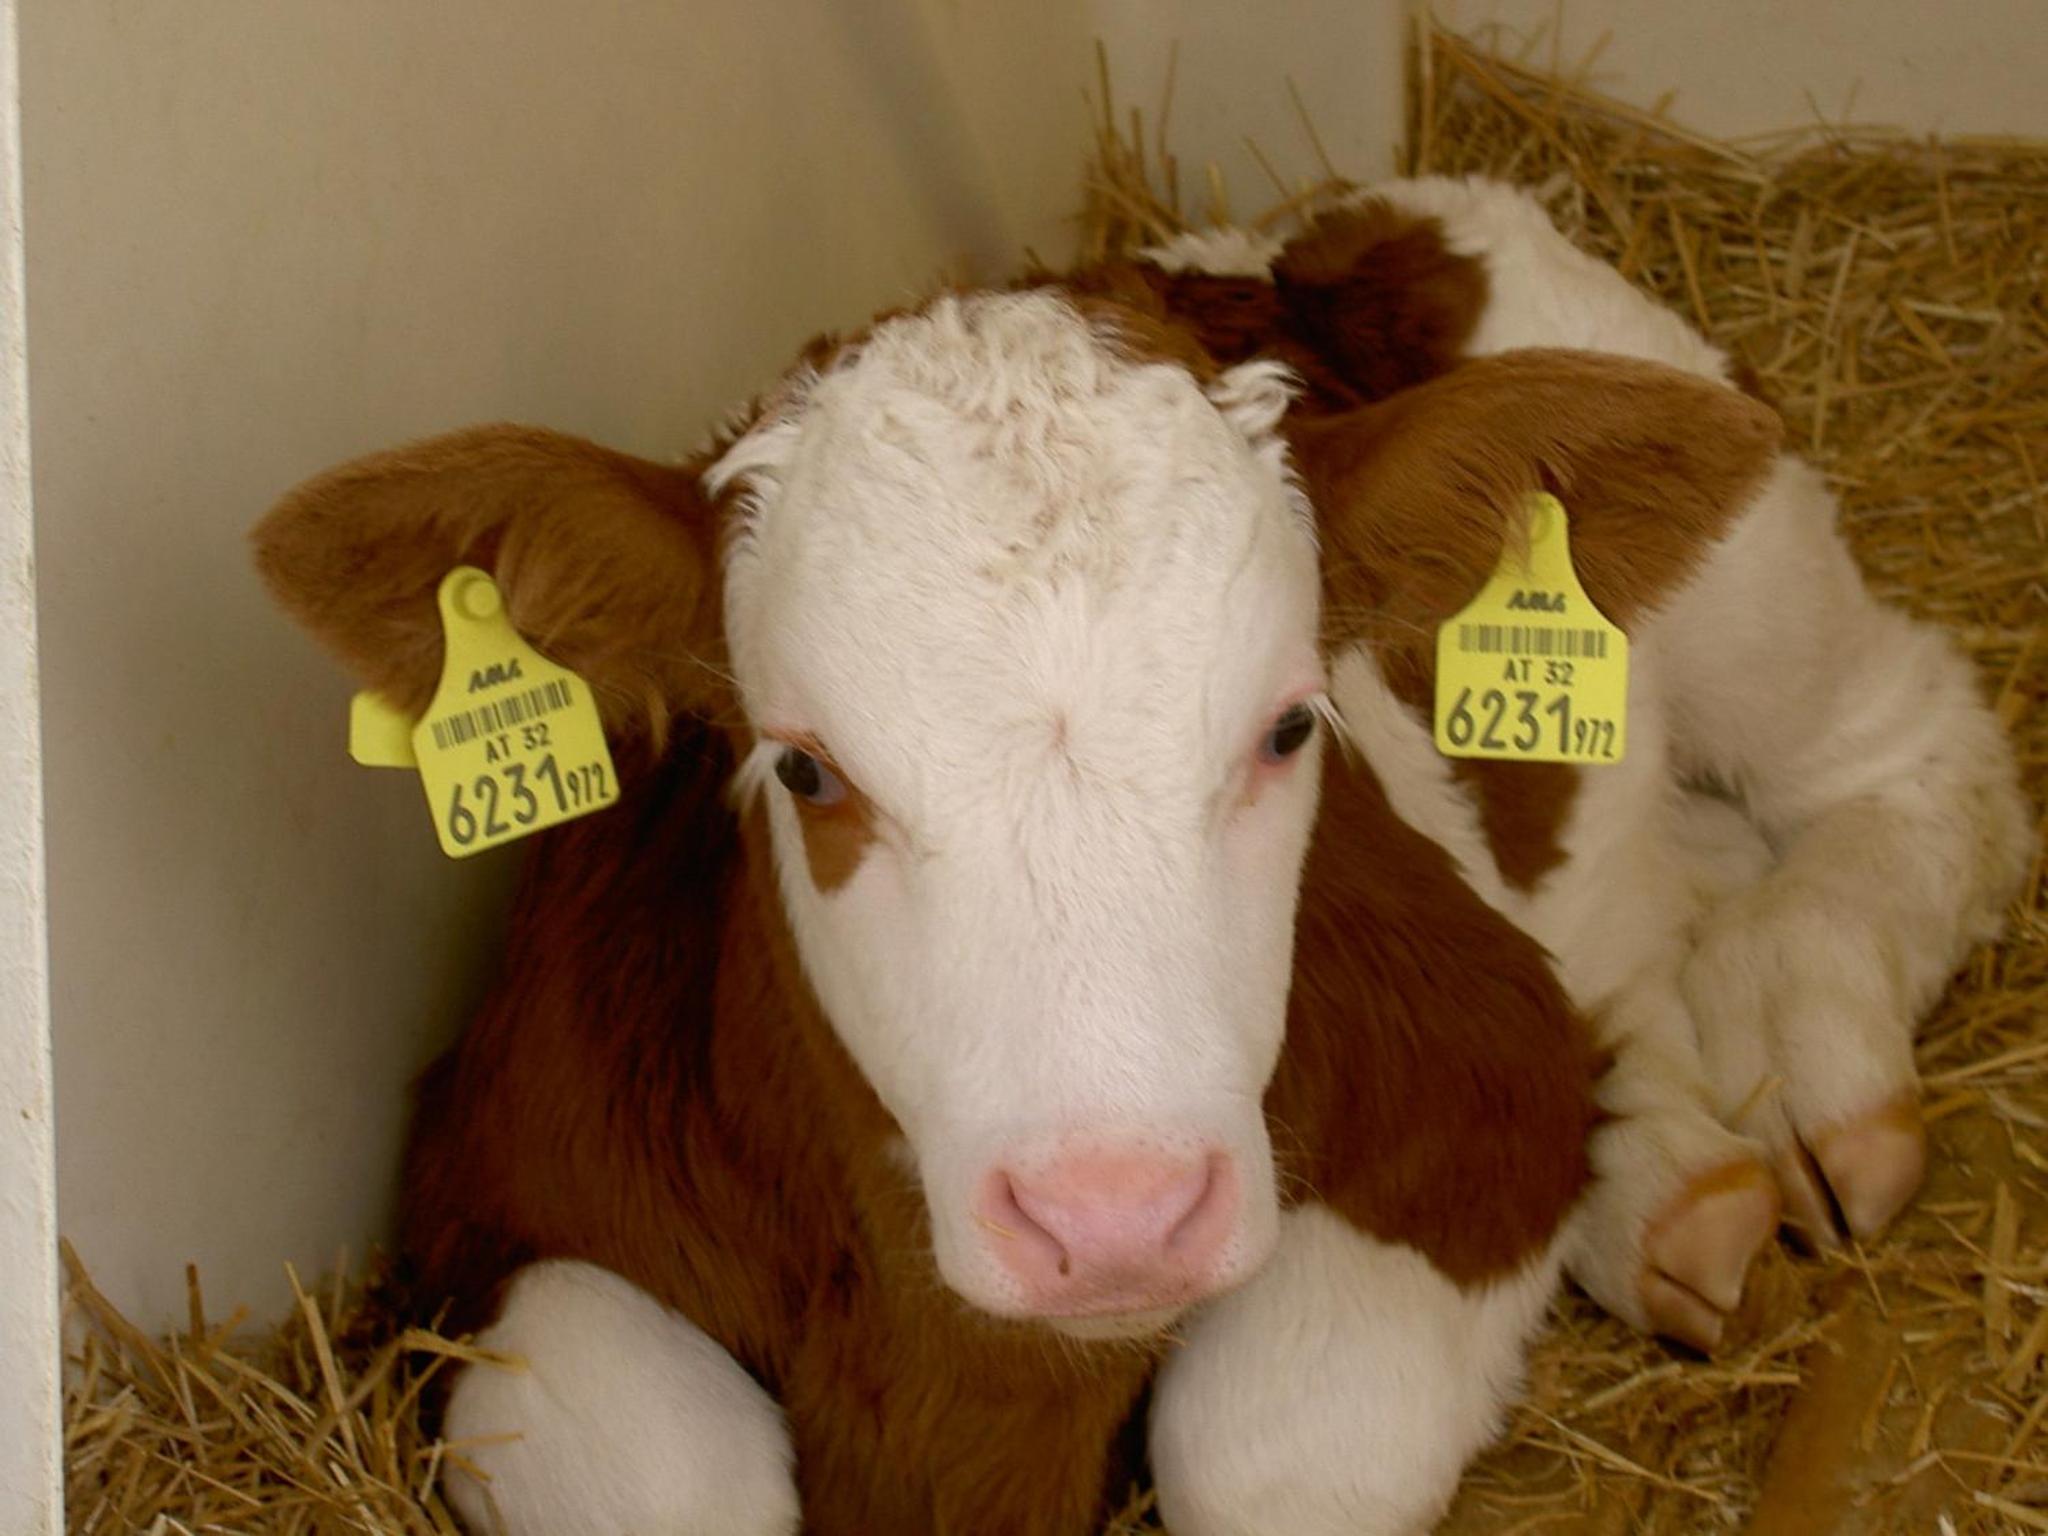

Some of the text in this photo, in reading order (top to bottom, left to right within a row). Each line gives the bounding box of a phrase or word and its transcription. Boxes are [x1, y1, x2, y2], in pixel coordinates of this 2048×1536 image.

[1503, 659, 1575, 687] AT 32
[485, 722, 553, 763] AT 32
[1446, 687, 1571, 755] 6231
[448, 753, 569, 846] 6231
